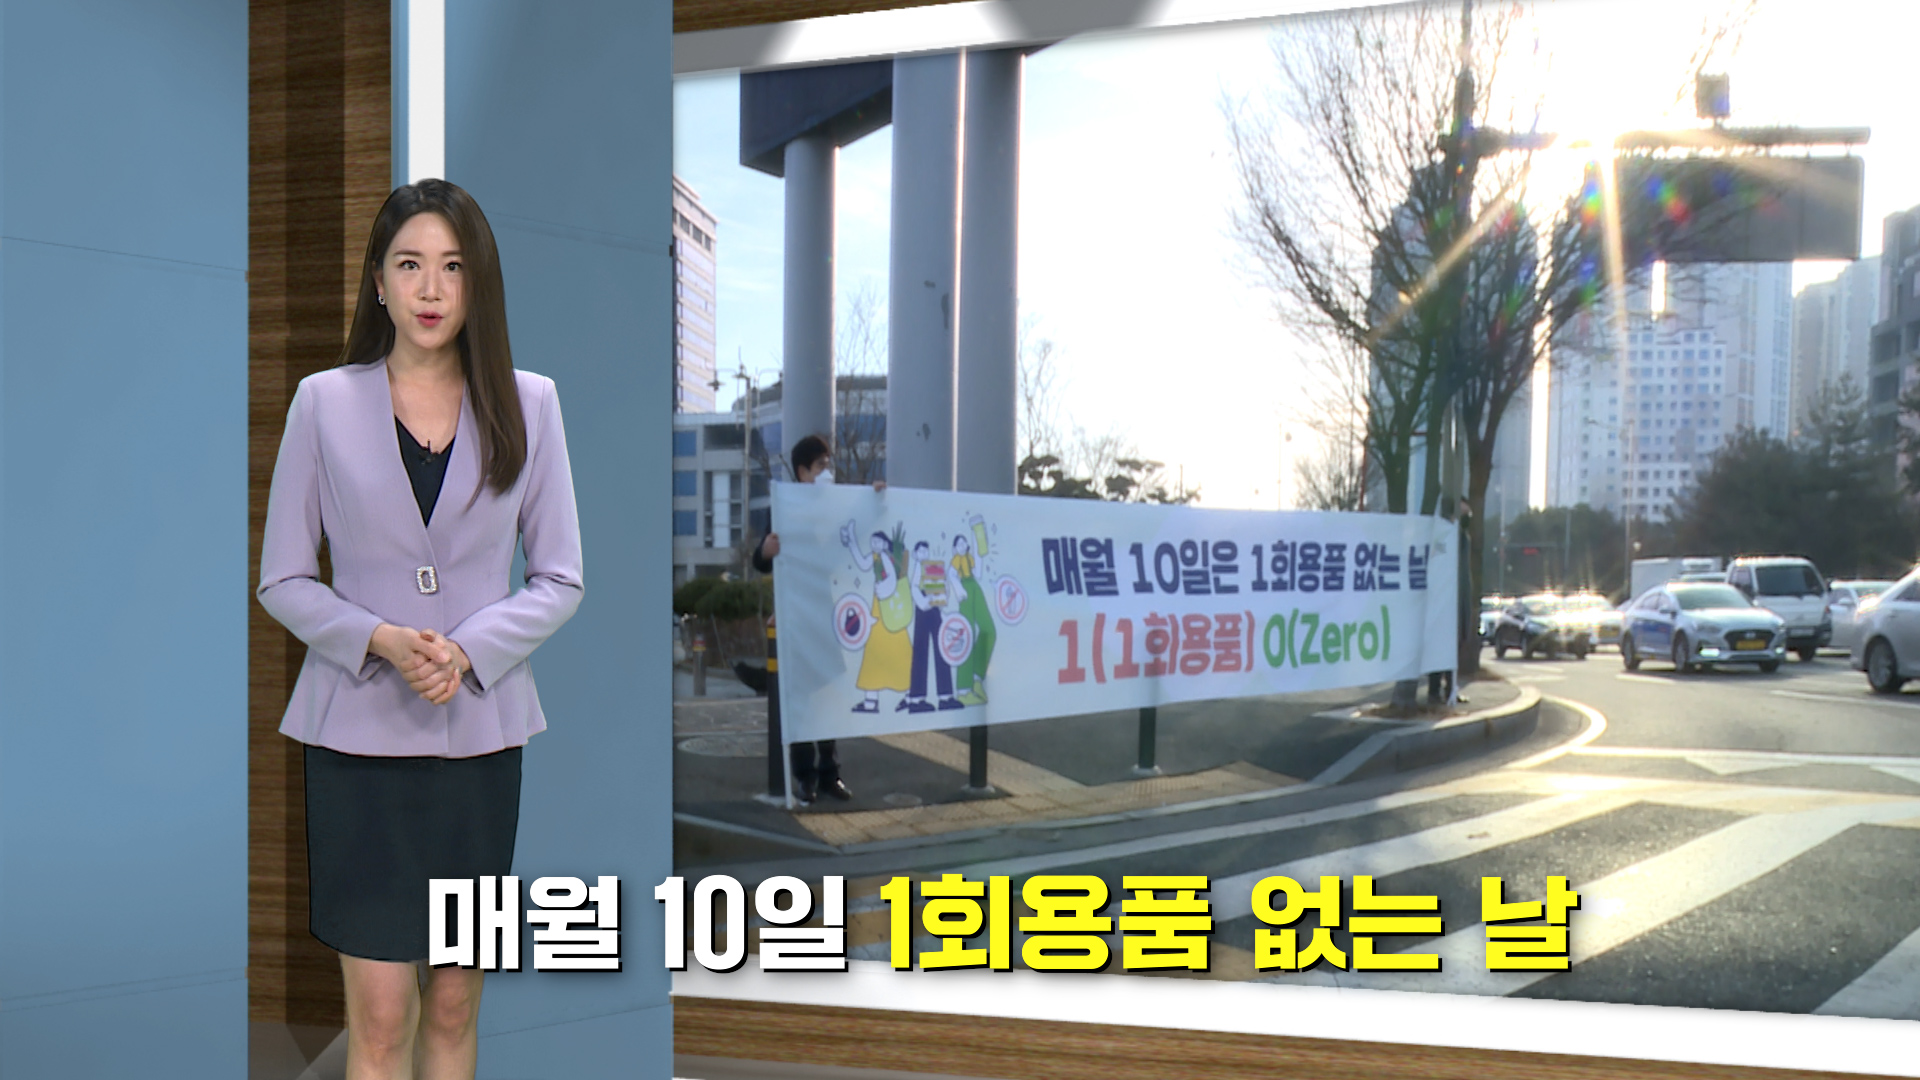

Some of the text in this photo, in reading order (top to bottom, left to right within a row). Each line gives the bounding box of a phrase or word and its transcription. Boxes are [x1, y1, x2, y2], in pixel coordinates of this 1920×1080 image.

[1041, 536, 1120, 597] 매월
[1128, 539, 1240, 595] 10일은
[1251, 540, 1348, 592] 1회용품
[1353, 542, 1401, 592] 없는
[1057, 609, 1256, 685] 1(1회용품)
